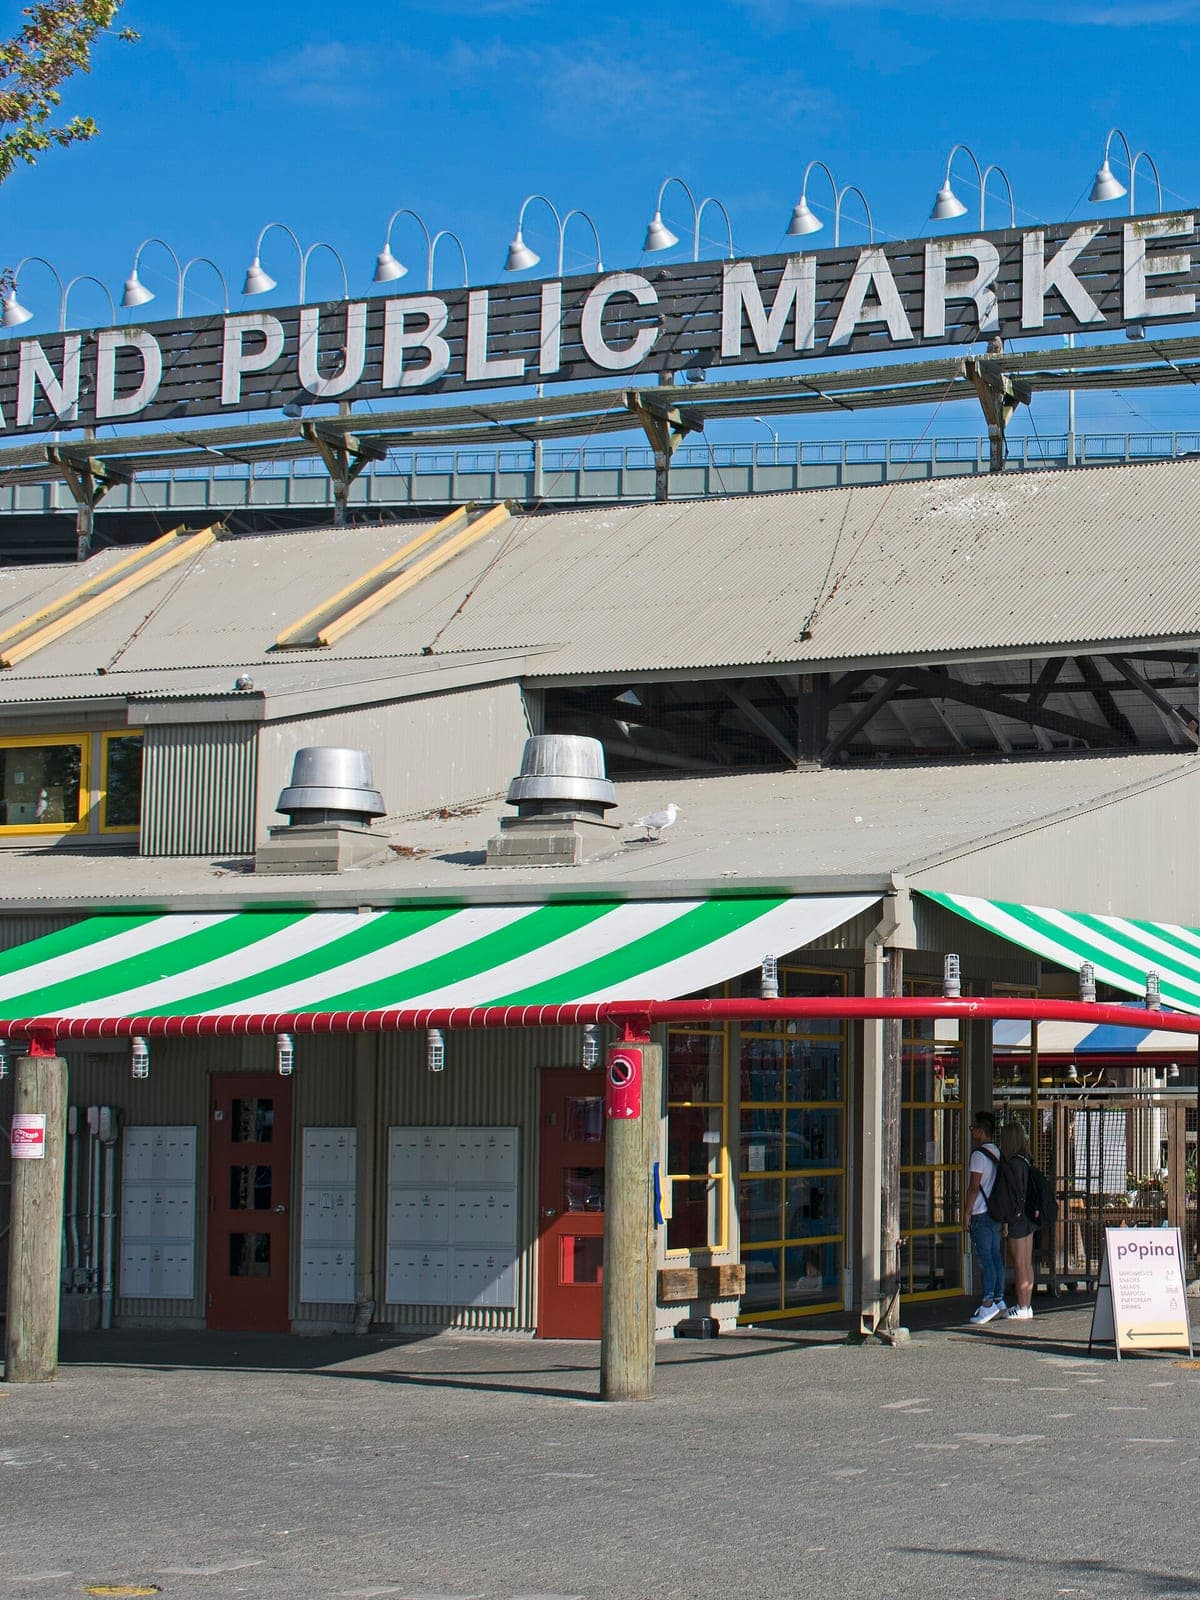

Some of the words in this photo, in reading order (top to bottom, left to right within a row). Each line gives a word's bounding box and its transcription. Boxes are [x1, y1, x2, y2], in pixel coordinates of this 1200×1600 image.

[0, 329, 162, 428] ND
[221, 273, 659, 405] PUBLIC
[1117, 1241, 1175, 1260] popina
